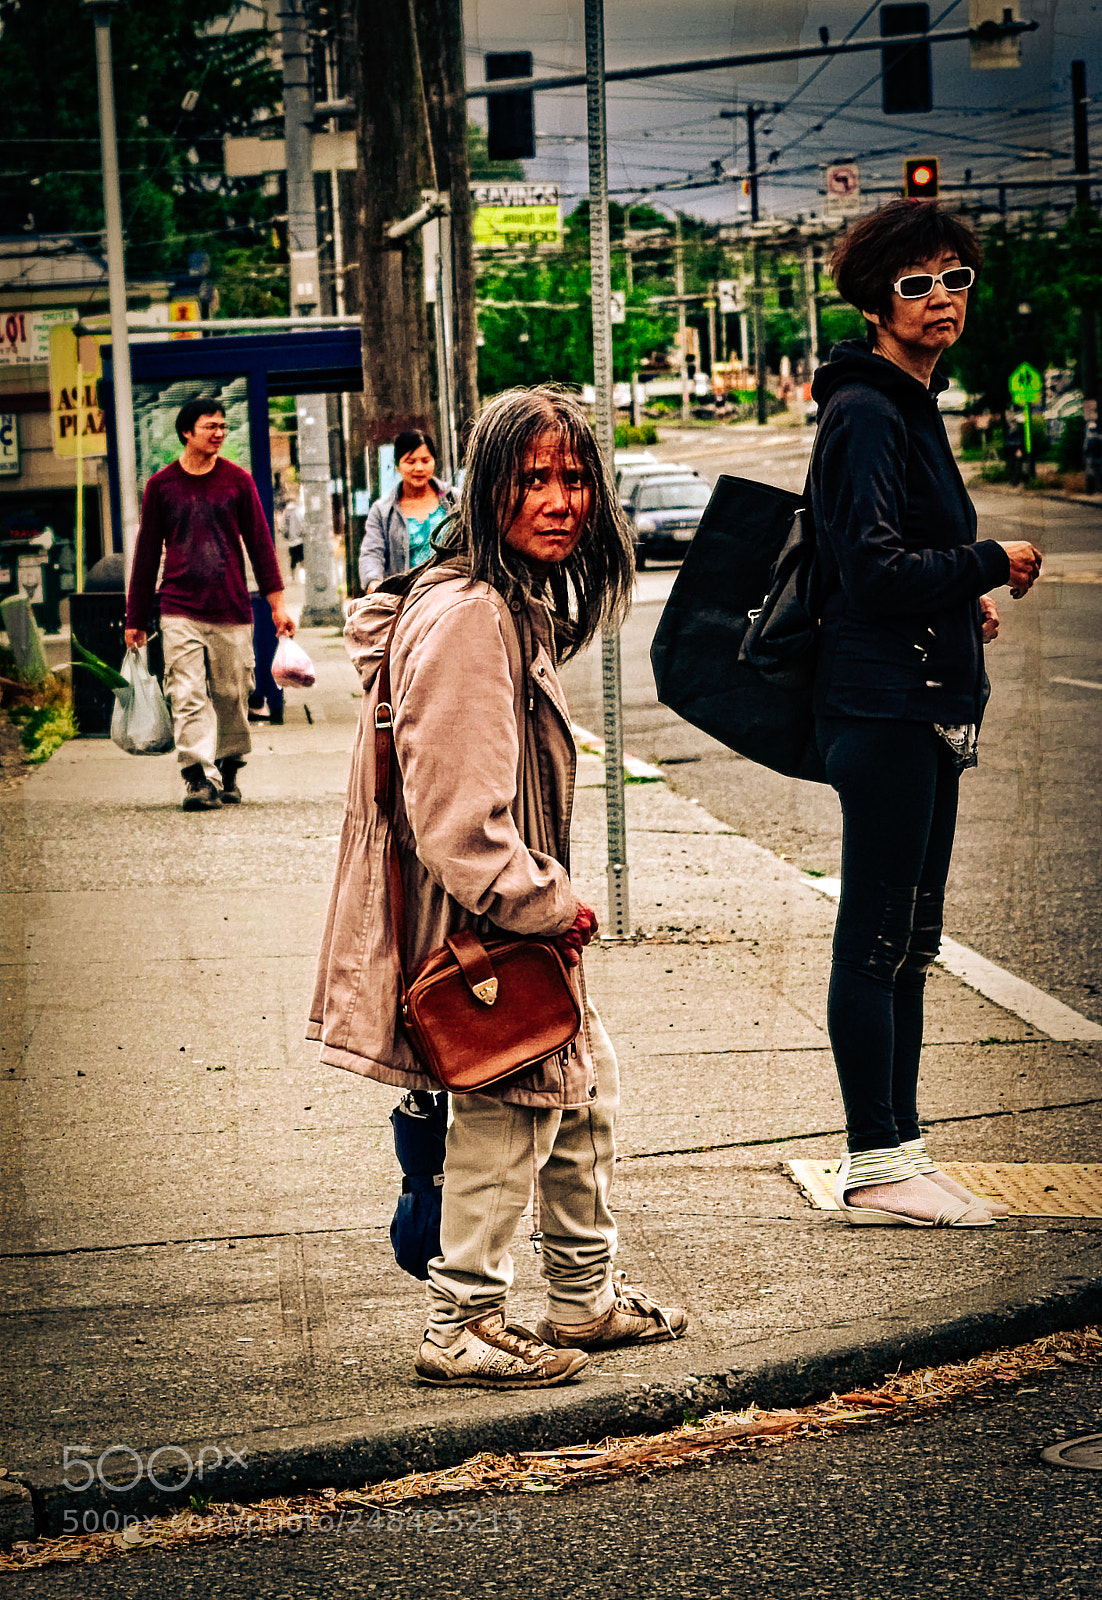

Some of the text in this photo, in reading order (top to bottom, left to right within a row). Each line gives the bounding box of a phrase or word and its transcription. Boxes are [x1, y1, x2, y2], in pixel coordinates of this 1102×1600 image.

[471, 186, 559, 207] SAVINGS
[505, 231, 557, 243] GEICO
[58, 385, 97, 410] ASI
